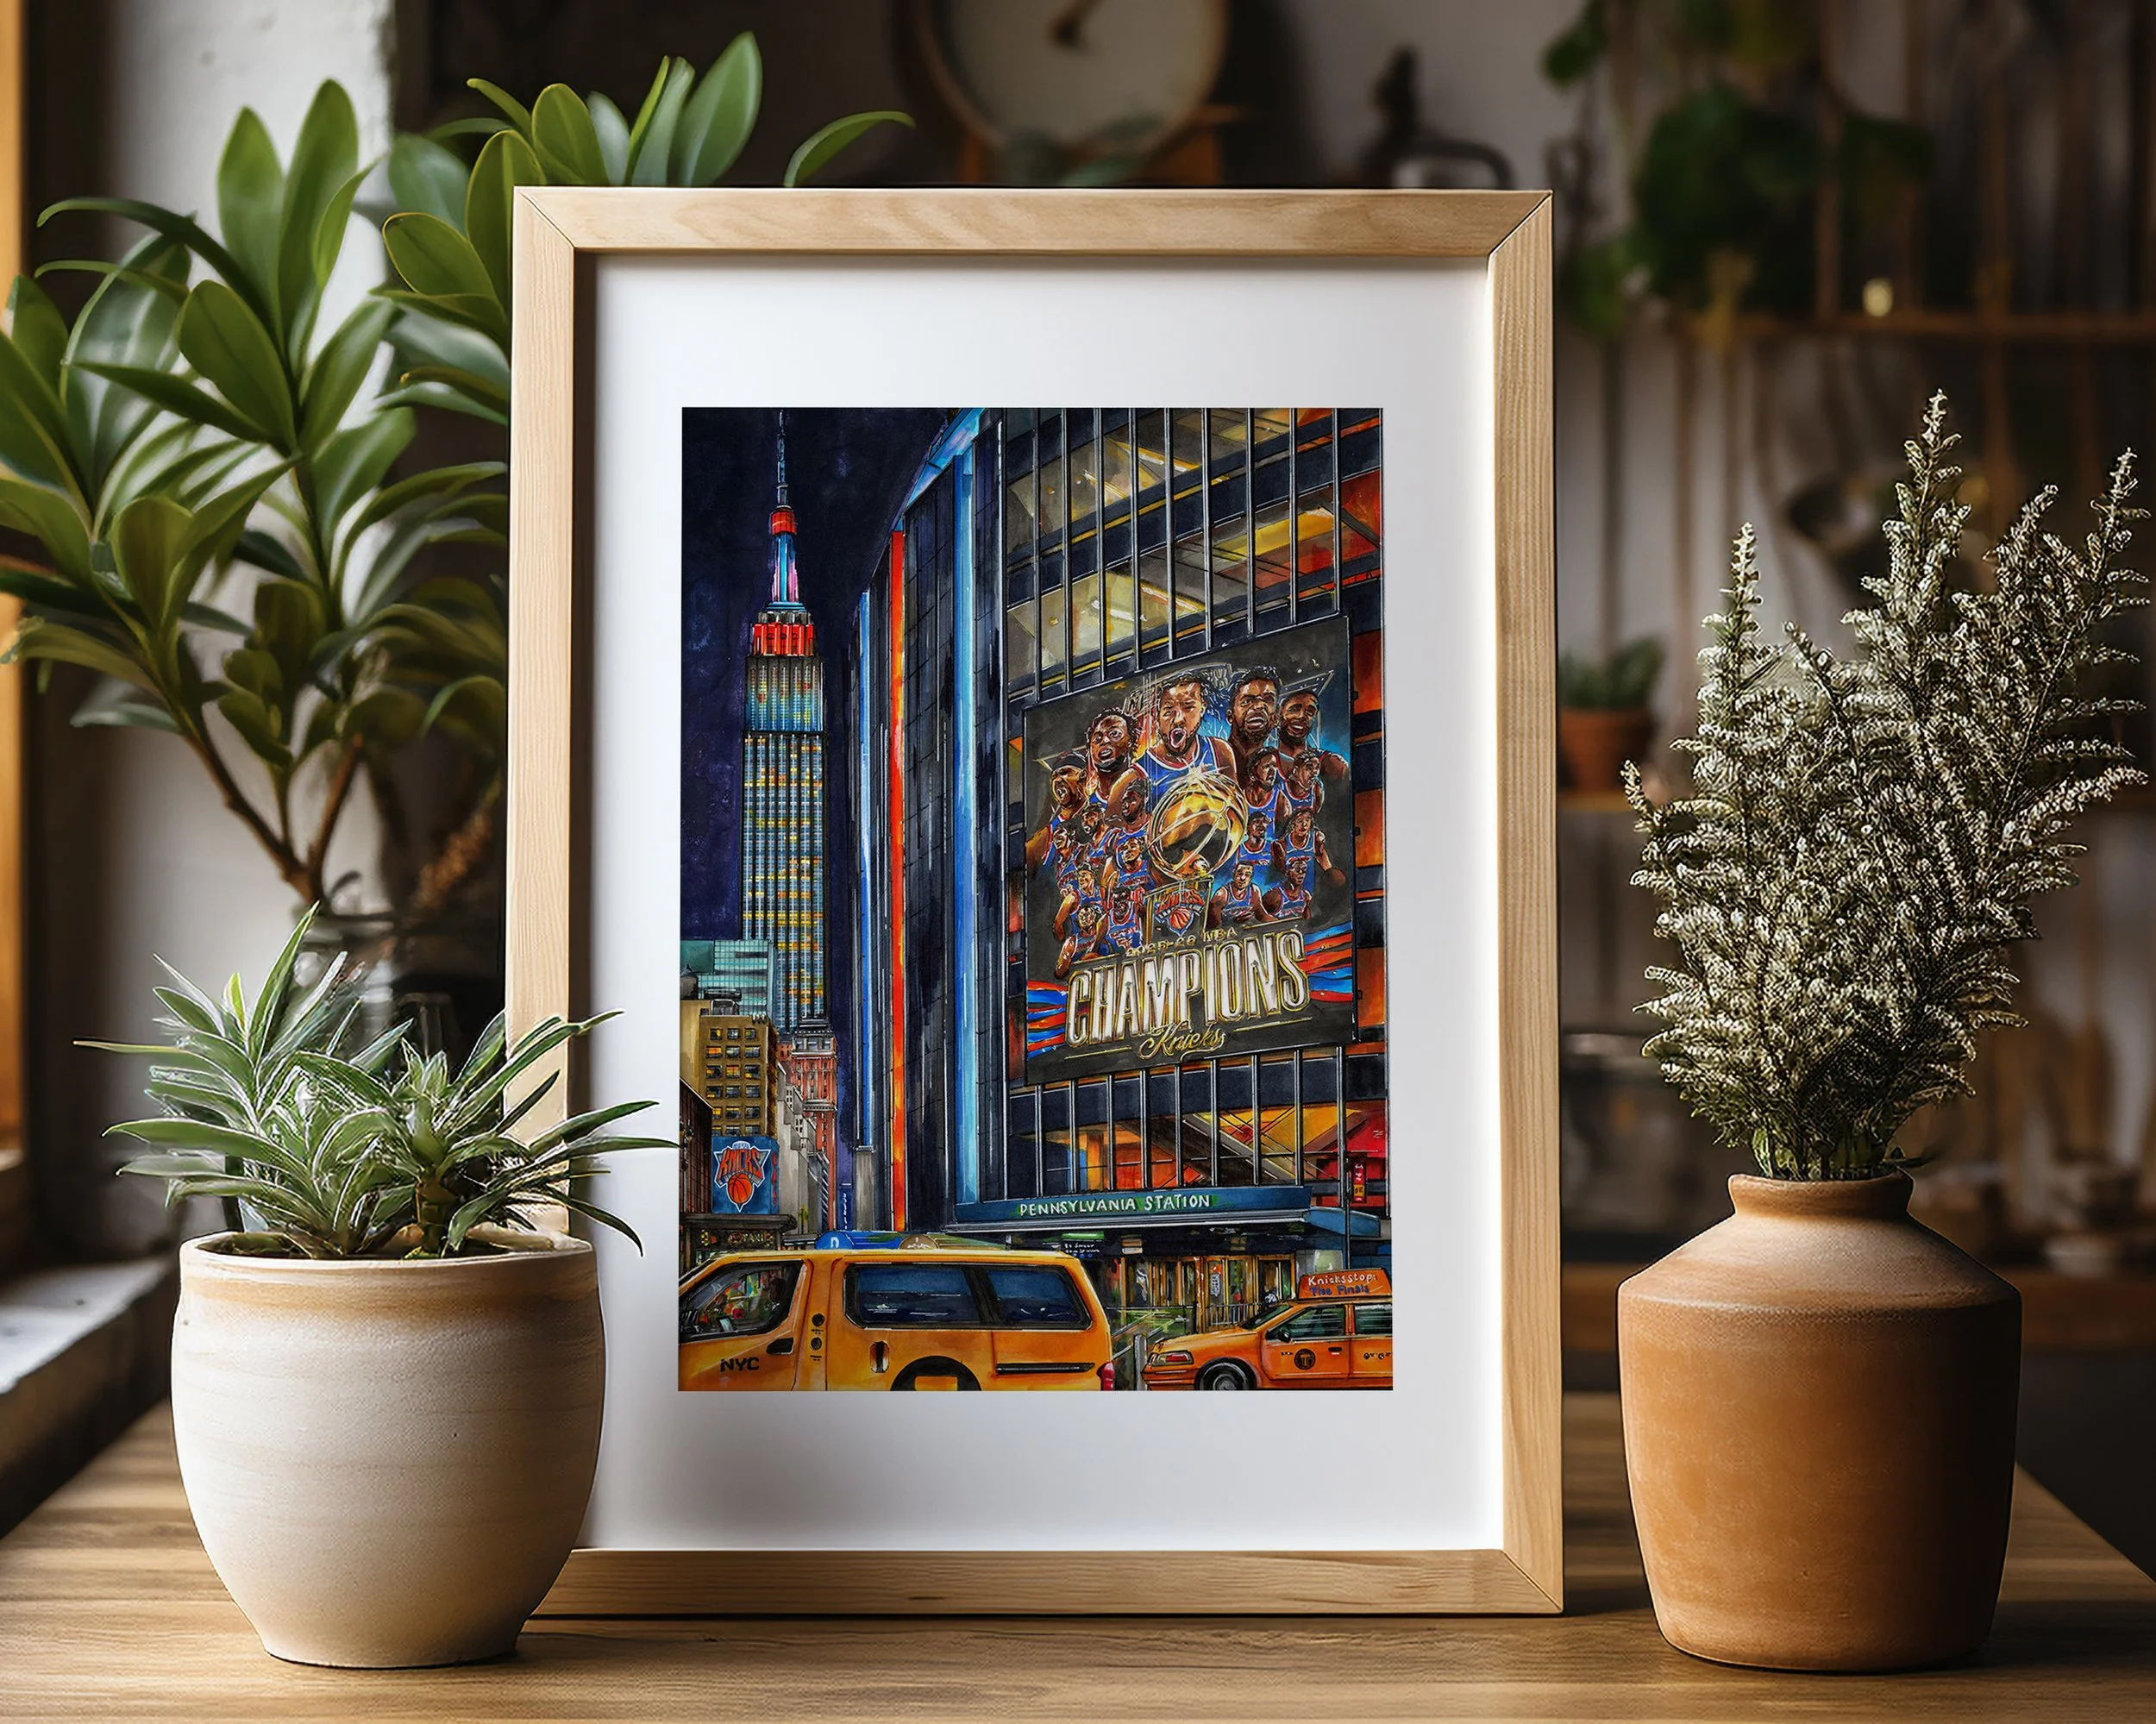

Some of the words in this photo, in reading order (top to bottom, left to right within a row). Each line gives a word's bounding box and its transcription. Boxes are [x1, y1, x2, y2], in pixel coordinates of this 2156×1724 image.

[1065, 929, 1309, 1047] CHAMPIONS
[1138, 1021, 1225, 1063] Knicks
[717, 1149, 763, 1180] KNICKS
[1020, 1198, 1136, 1216] PENNSYLVANIA
[1144, 1194, 1210, 1212] STATION
[1309, 1285, 1332, 1296] The
[1337, 1284, 1369, 1295] Finals
[720, 1357, 760, 1372] NYC
